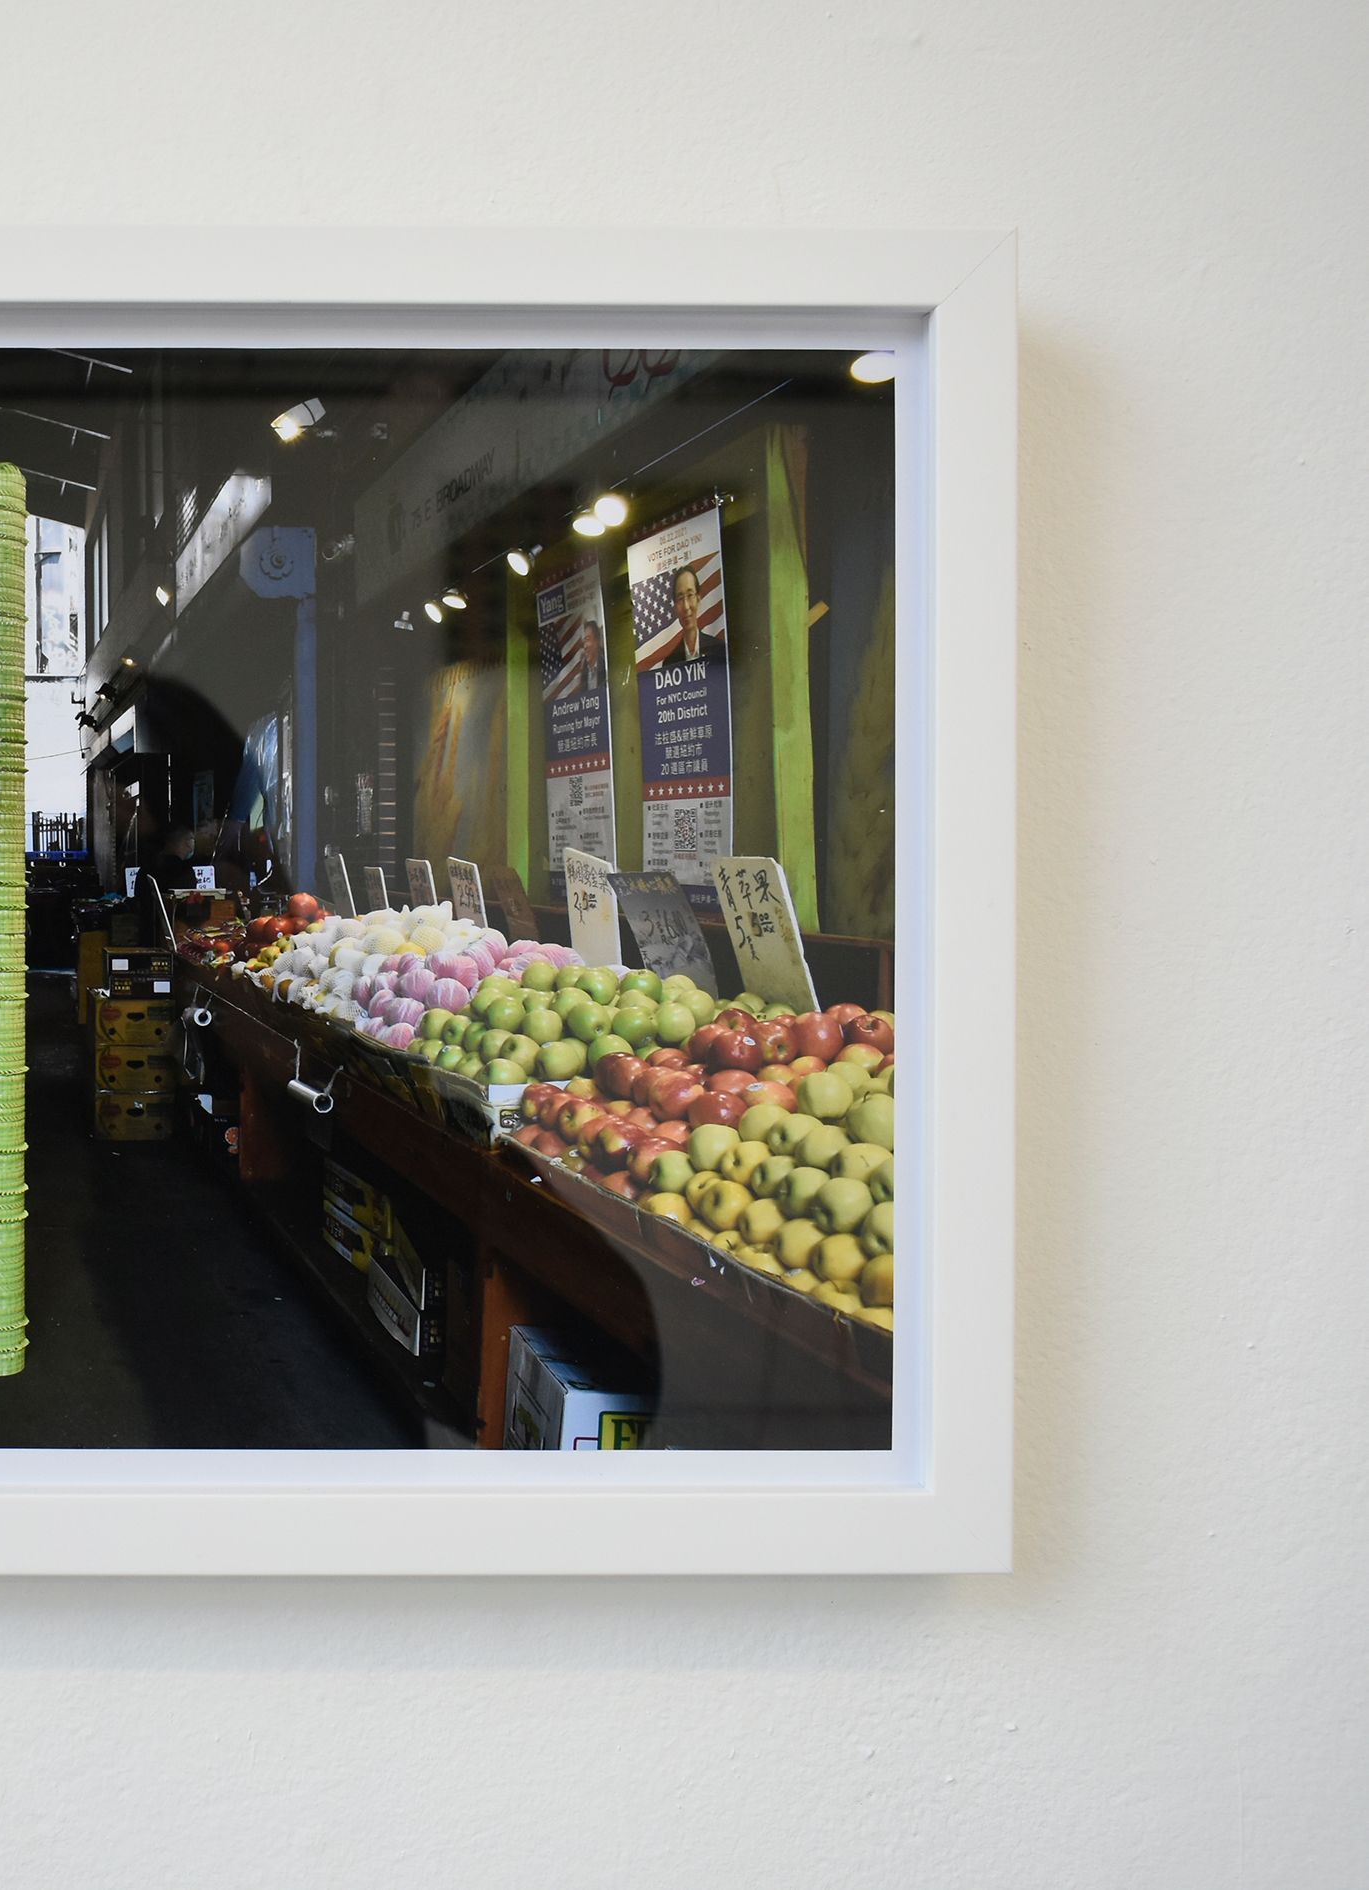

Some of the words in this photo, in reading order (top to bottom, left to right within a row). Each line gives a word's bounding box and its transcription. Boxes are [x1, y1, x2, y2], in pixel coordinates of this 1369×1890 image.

[436, 447, 495, 513] BROADWAY
[647, 549, 662, 562] VOTE
[663, 543, 676, 556] FOR
[676, 538, 690, 552] DAO
[540, 594, 565, 614] Yang
[655, 667, 682, 690] DAO
[684, 661, 707, 682] YIN
[656, 696, 667, 706] For
[668, 692, 682, 703] NYC
[683, 686, 708, 701] Council
[552, 701, 580, 717] Andrew
[580, 696, 600, 710] Yang
[657, 709, 676, 723] 20th
[677, 703, 708, 720] District
[552, 722, 575, 735] Running
[575, 718, 584, 730] for
[583, 715, 601, 729] Mayor
[660, 763, 670, 776] 20
